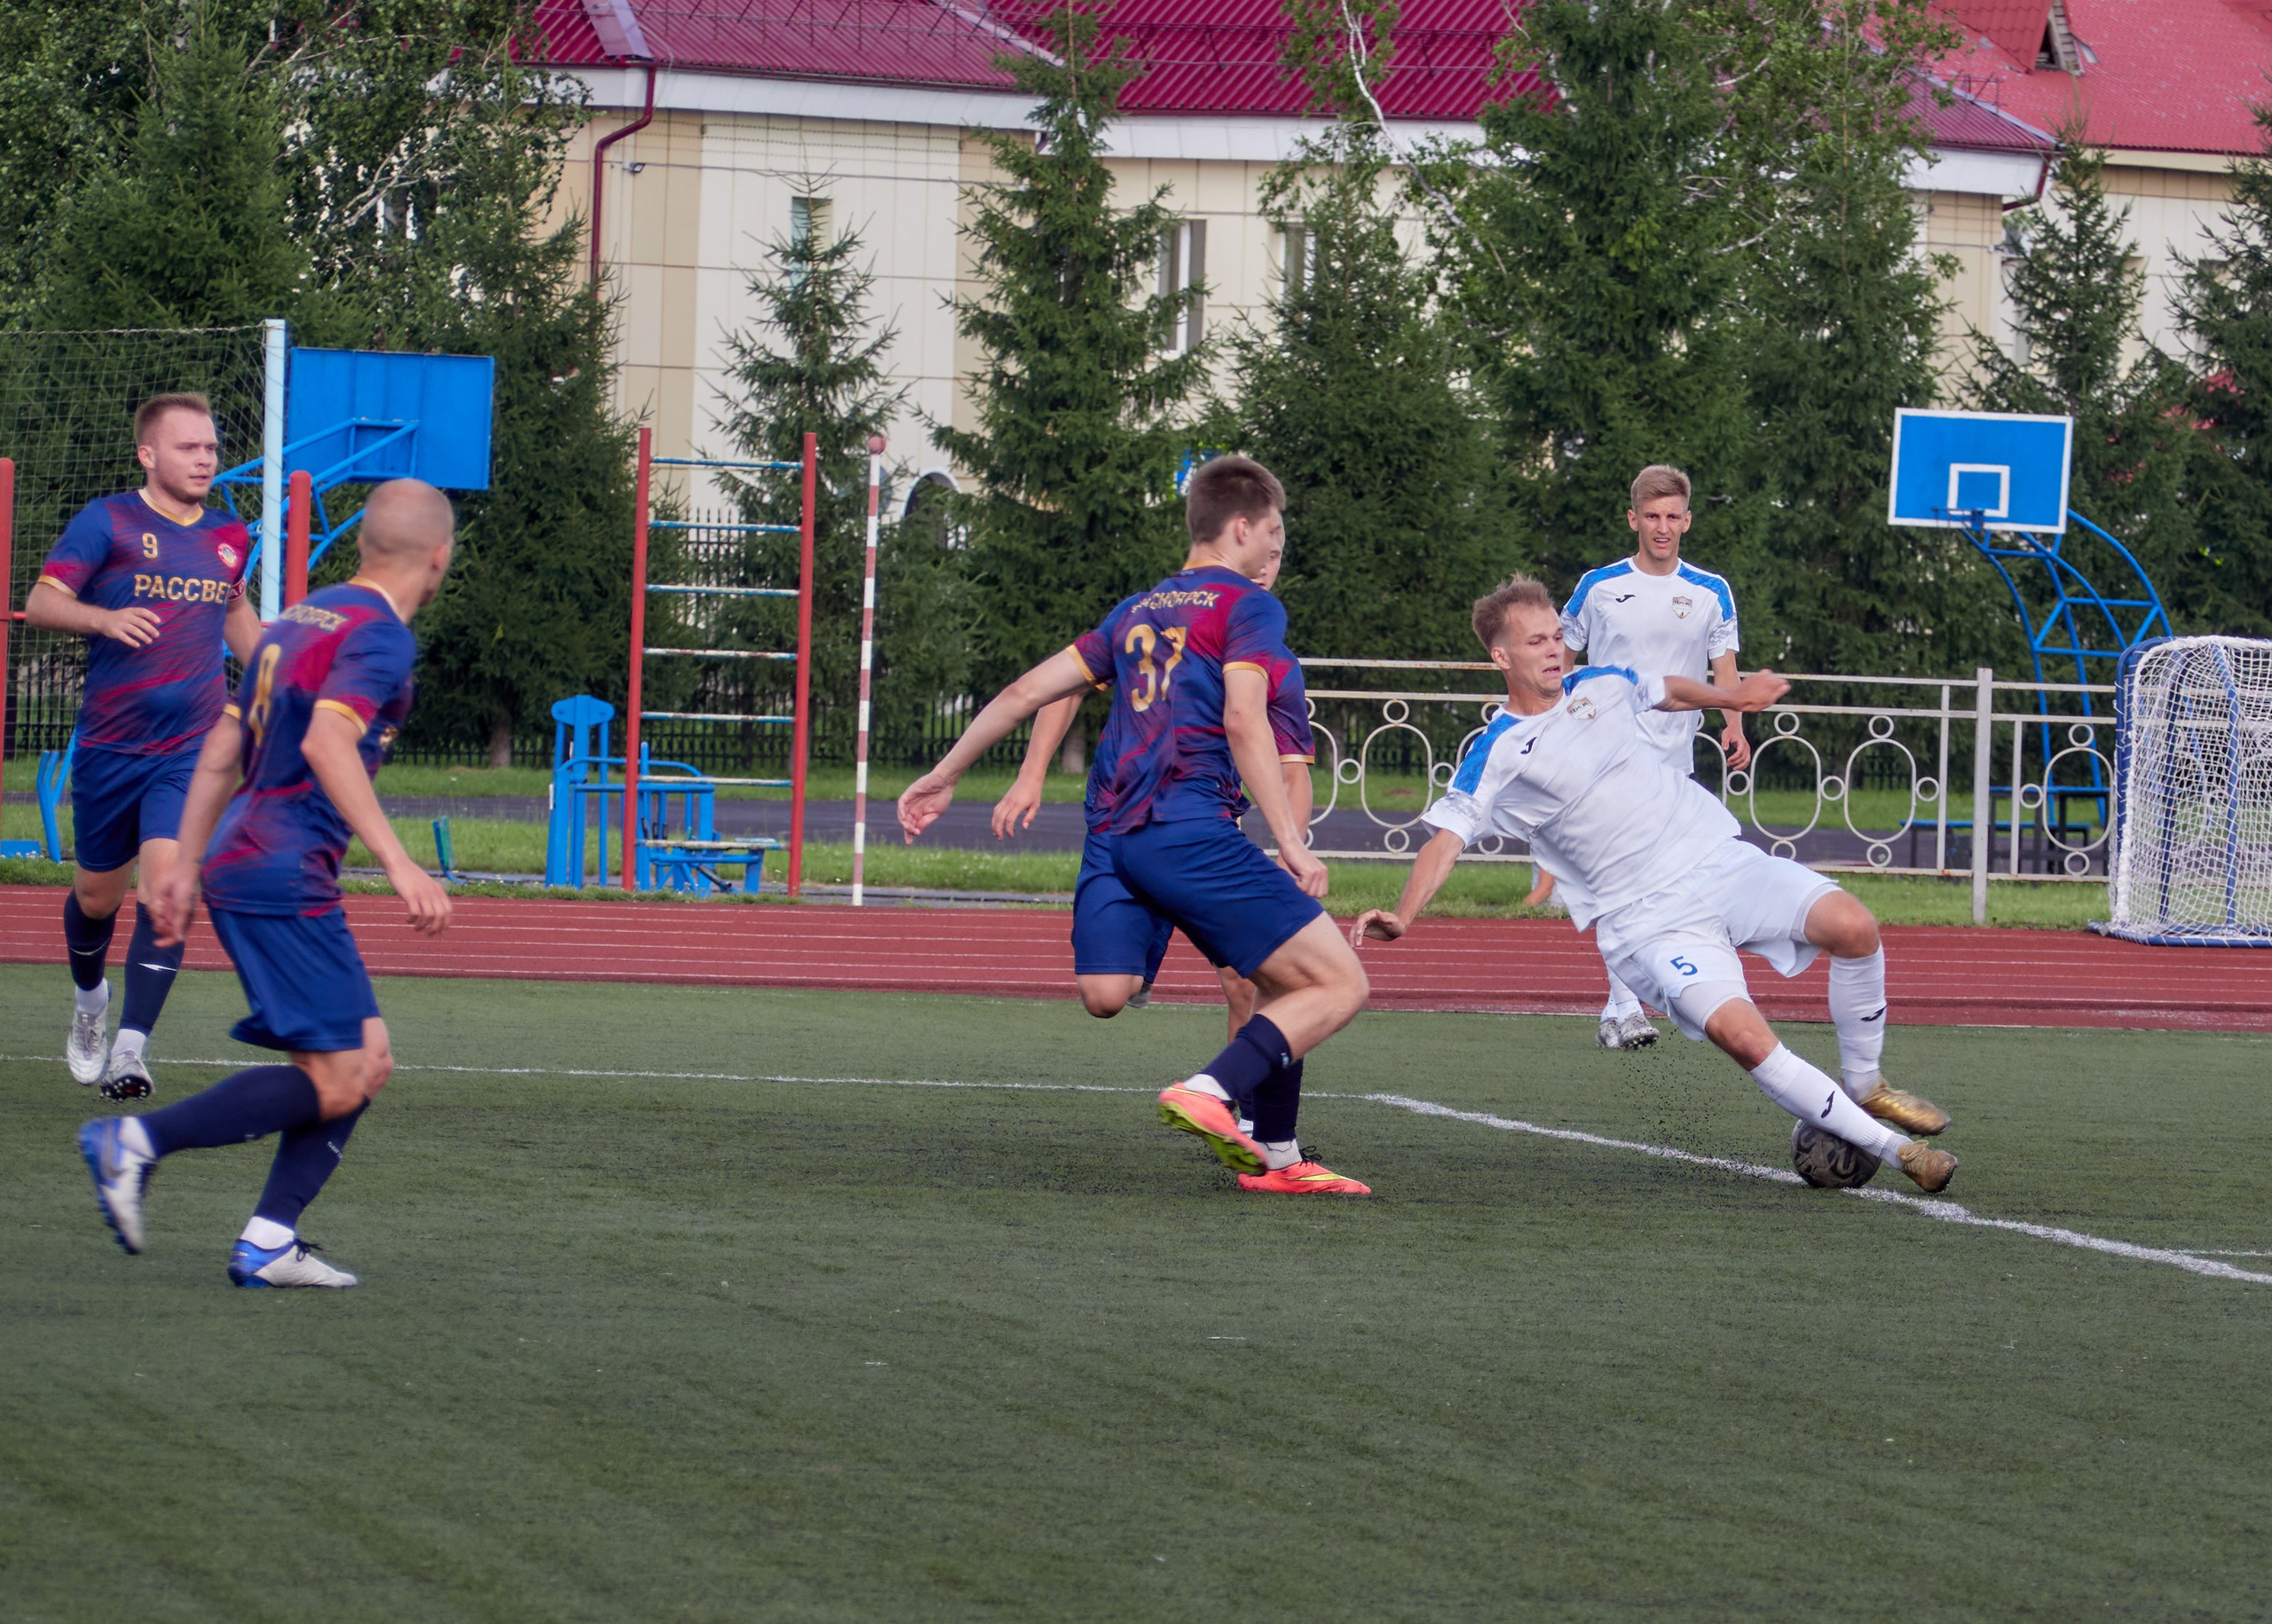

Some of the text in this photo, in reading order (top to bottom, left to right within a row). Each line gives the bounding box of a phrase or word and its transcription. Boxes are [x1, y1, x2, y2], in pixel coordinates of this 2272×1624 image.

[142, 532, 158, 559] 9
[1124, 623, 1187, 713] 37
[1669, 955, 1698, 976] 5
